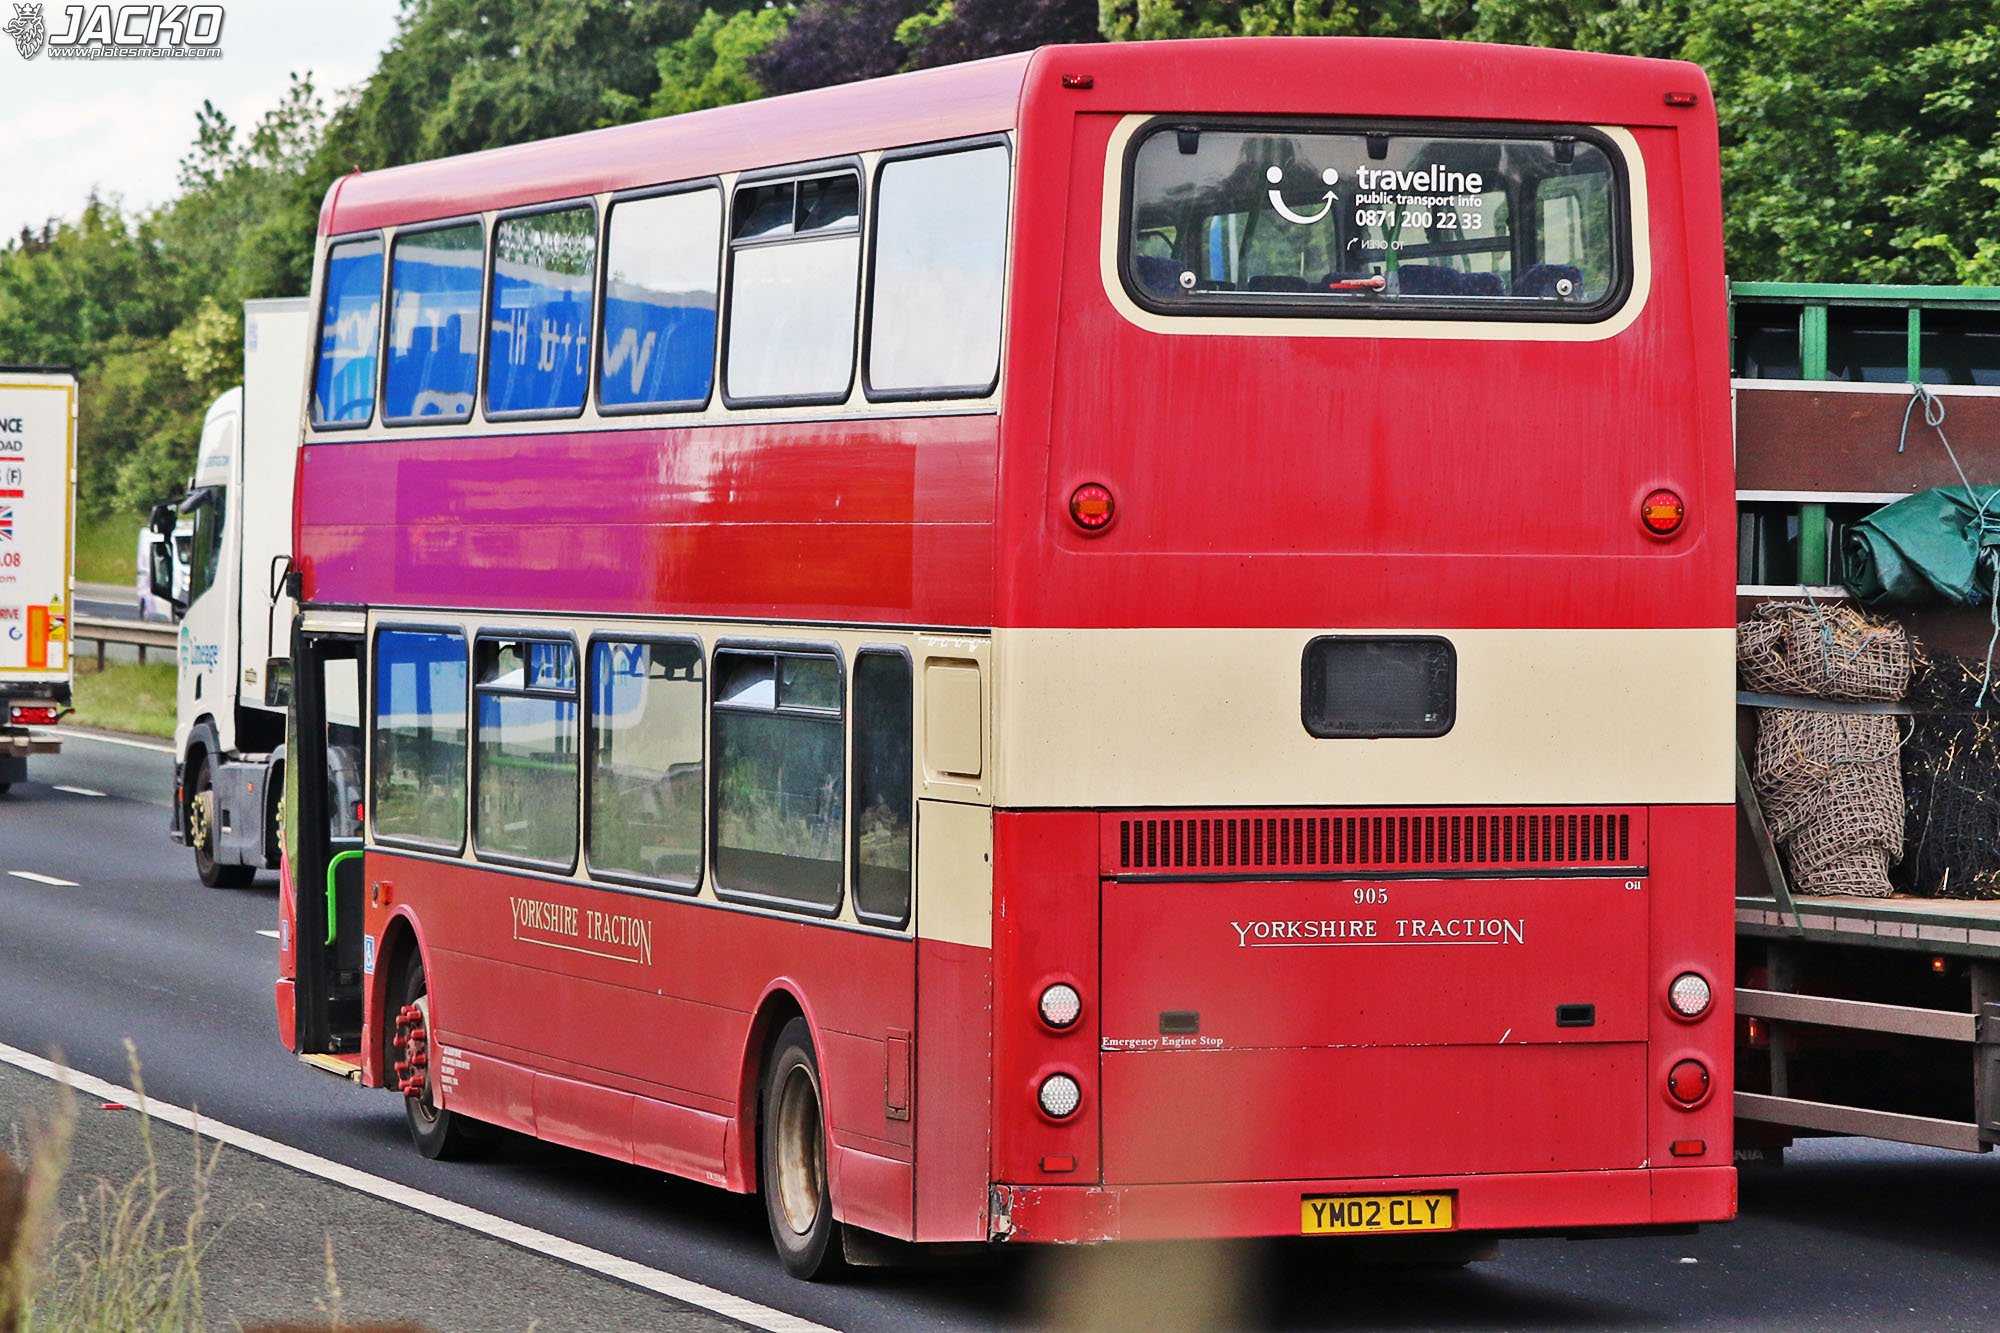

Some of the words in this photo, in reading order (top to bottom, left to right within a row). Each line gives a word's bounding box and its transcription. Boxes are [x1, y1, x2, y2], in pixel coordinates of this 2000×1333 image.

[1356, 165, 1483, 193] traveline
[1355, 192, 1393, 206] public
[1396, 194, 1455, 208] transport
[1458, 195, 1482, 207] info
[1355, 210, 1396, 227] 0871
[1401, 211, 1433, 228] 200
[1436, 213, 1458, 229] 22
[1461, 213, 1482, 230] 33
[1624, 880, 1641, 890] Oil
[1353, 887, 1388, 904] 905
[509, 896, 579, 940] YORKSHIRE
[586, 910, 652, 966] TRACTION
[1231, 920, 1378, 947] YORKSHIRE
[1395, 919, 1525, 944] TRACTION
[1101, 1036, 1158, 1048] Emergency
[1161, 1036, 1197, 1047] Engine
[1199, 1036, 1224, 1047] Stop
[1311, 1201, 1380, 1228] YM02
[1389, 1199, 1440, 1225] CLY
